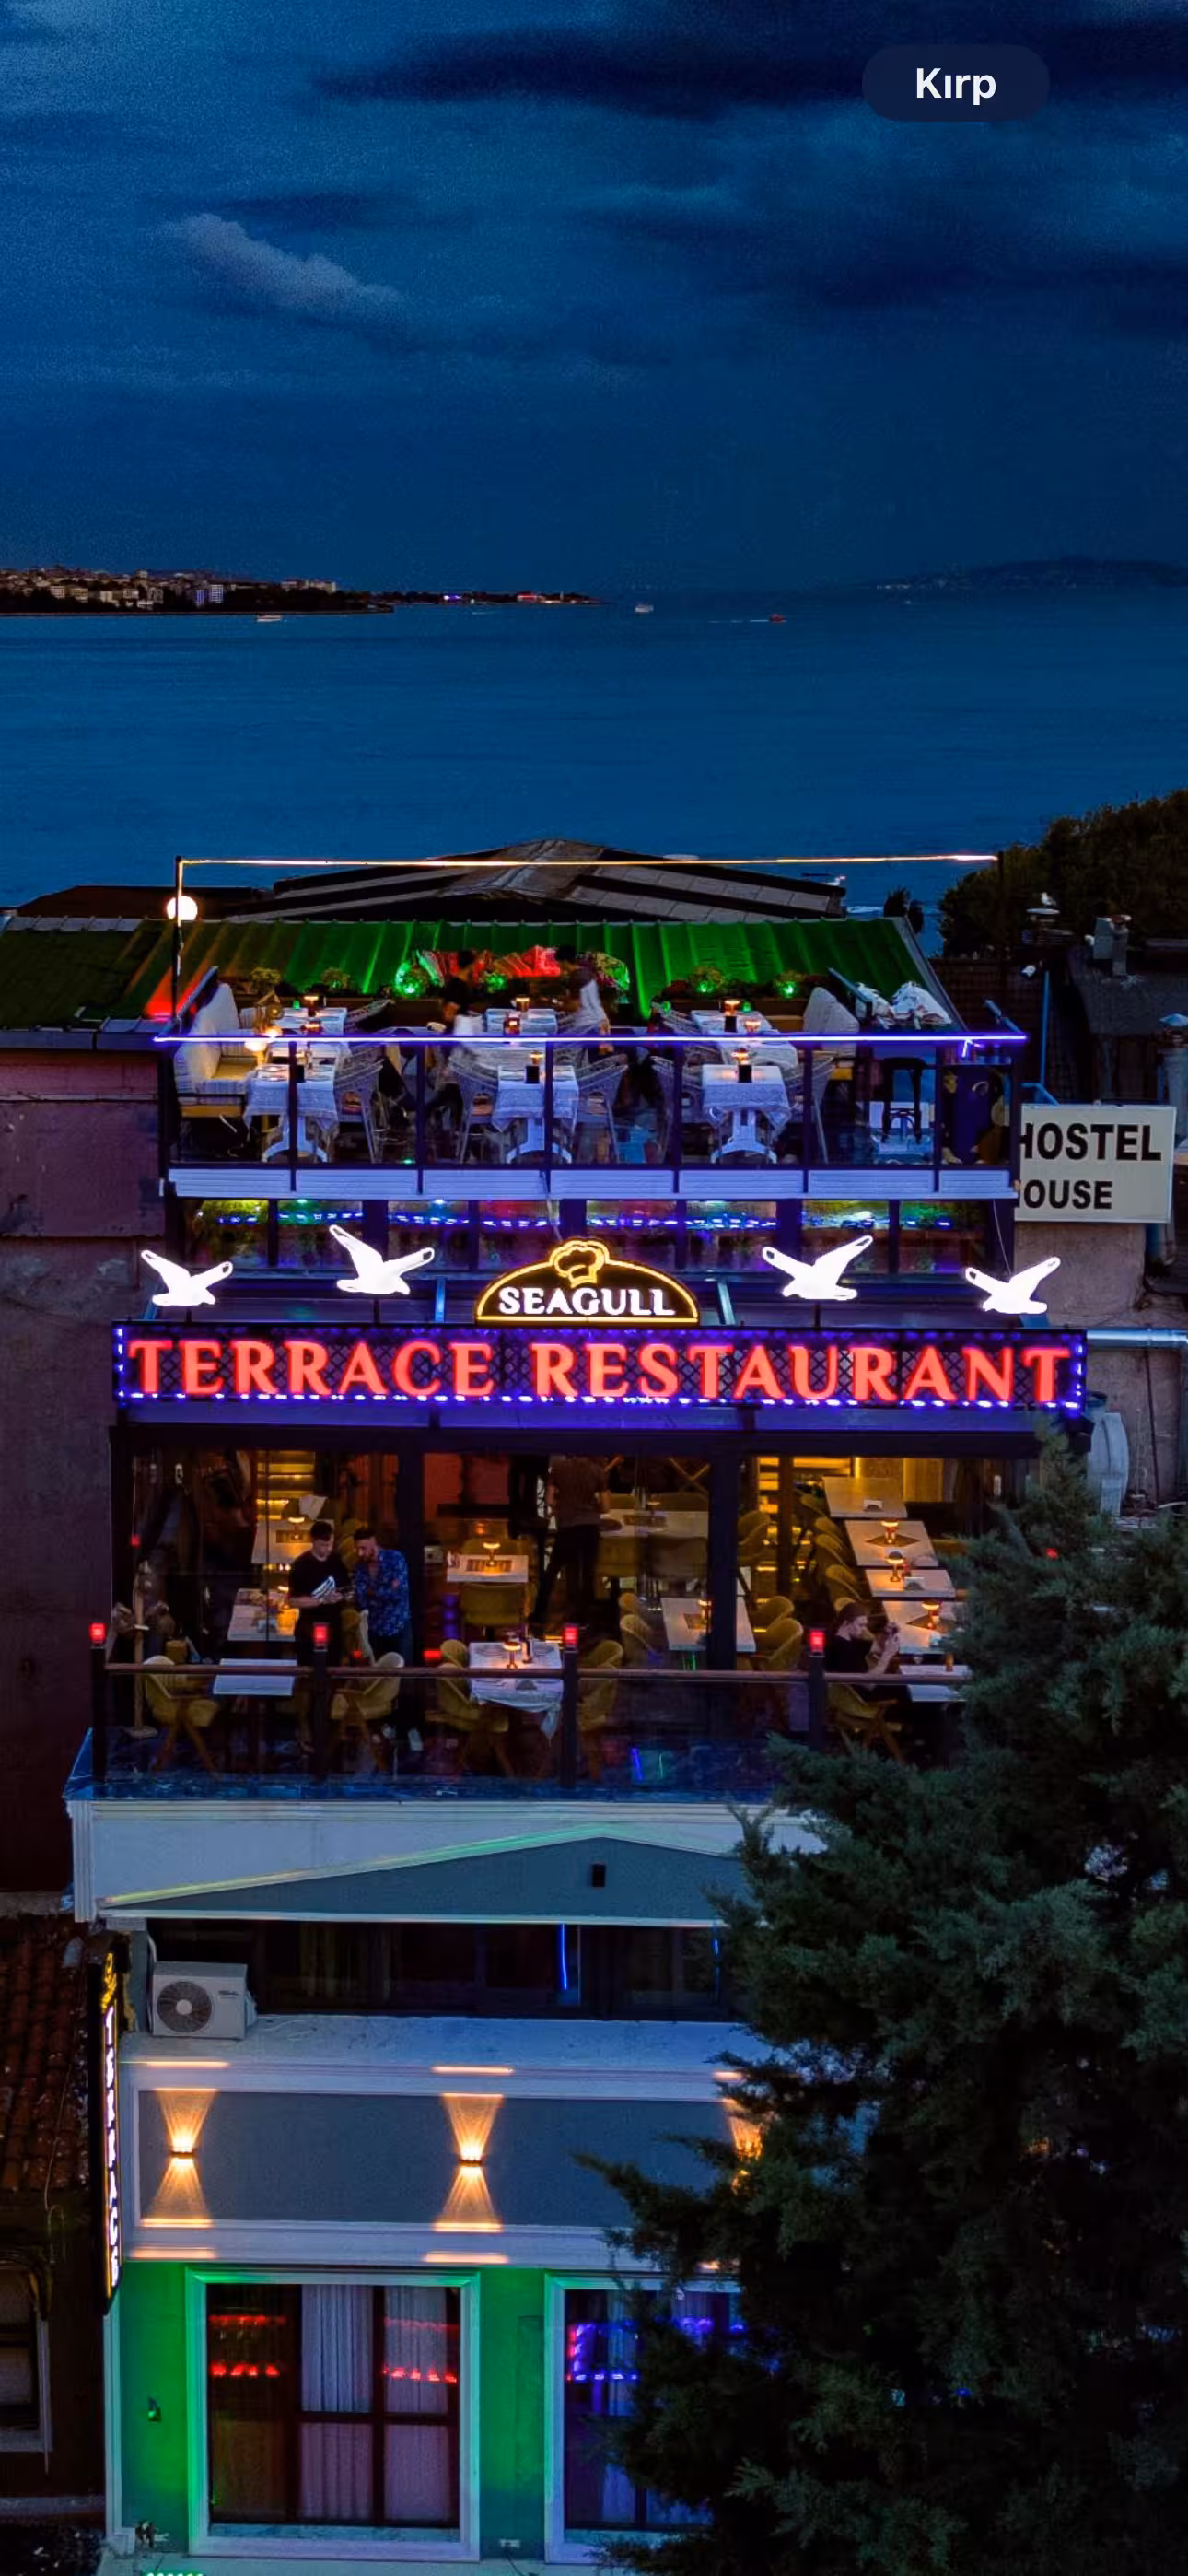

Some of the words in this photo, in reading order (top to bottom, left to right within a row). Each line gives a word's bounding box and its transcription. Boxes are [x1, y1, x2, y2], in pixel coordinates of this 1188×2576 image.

[1016, 1178, 1113, 1210] OUSE
[498, 1286, 675, 1316] SEAGULL
[127, 1339, 495, 1397] TERRACE
[529, 1341, 1071, 1403] RESTAURANT
